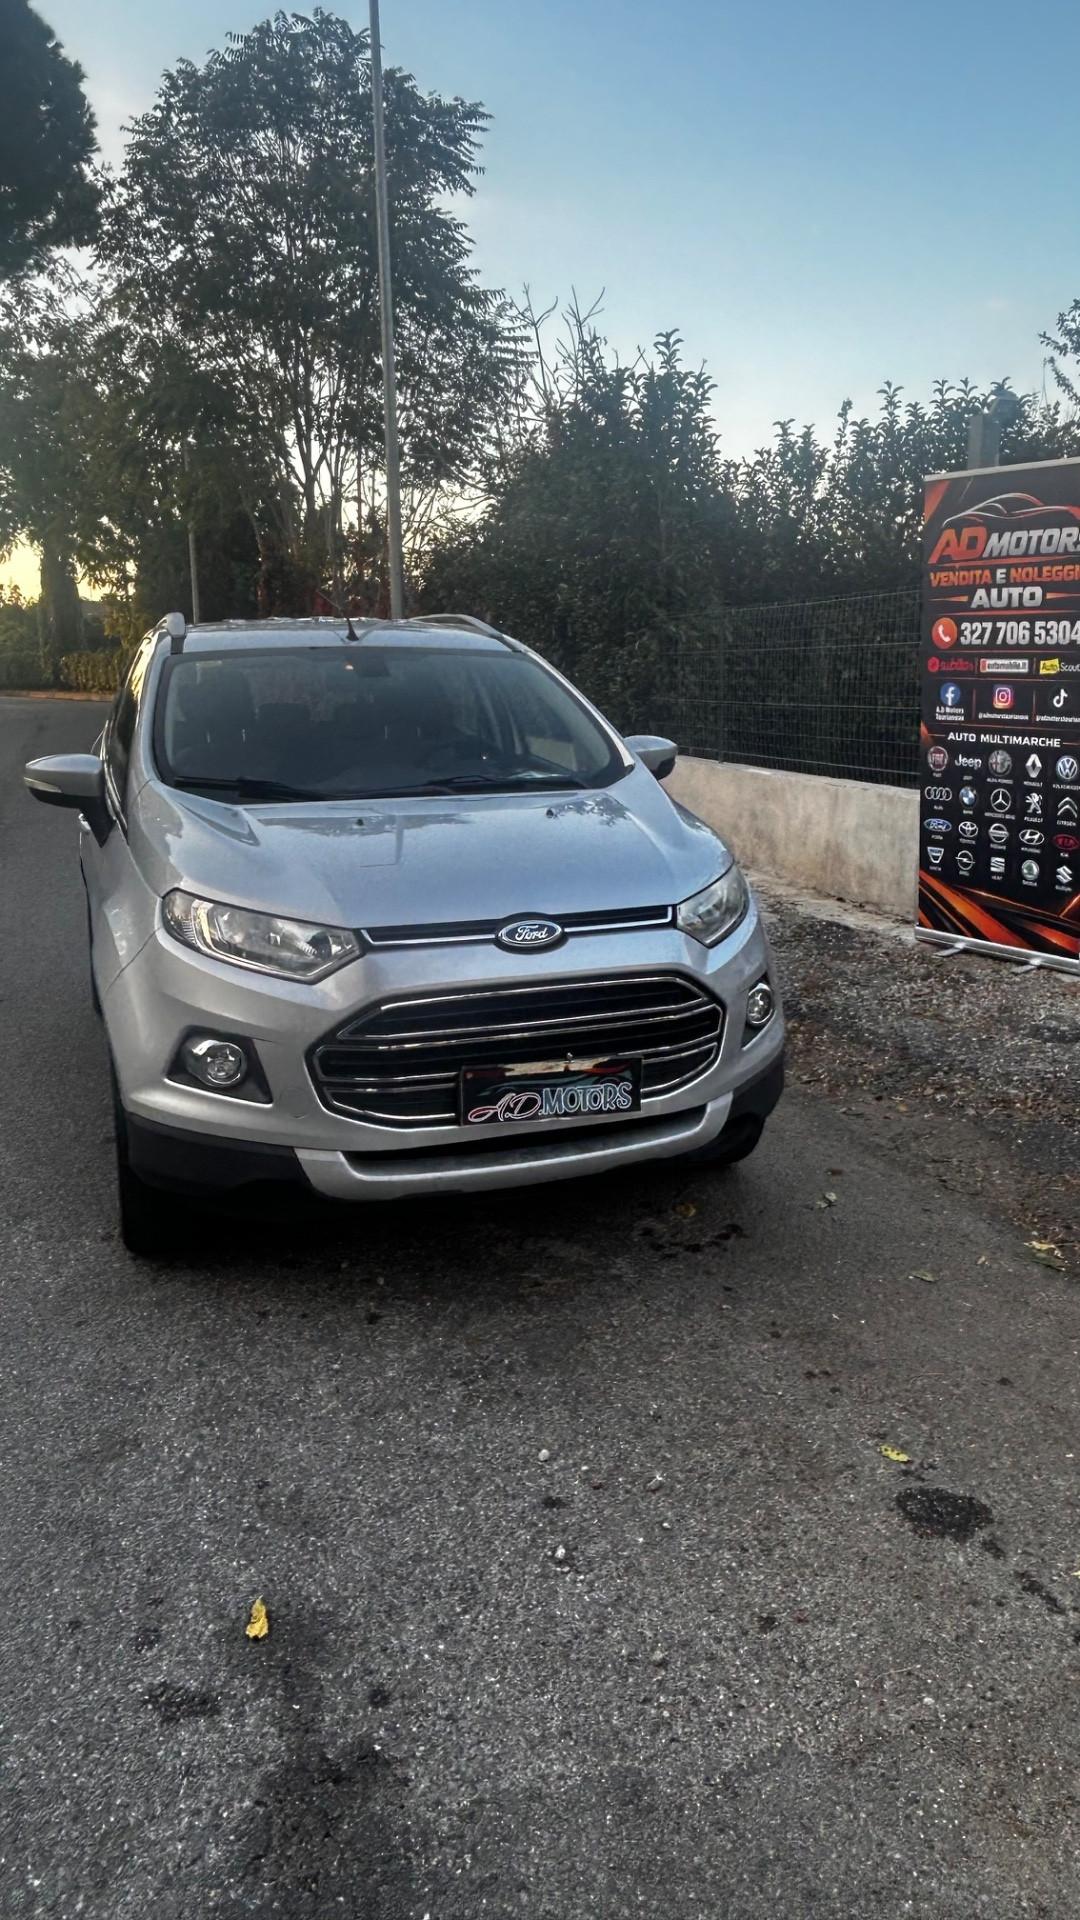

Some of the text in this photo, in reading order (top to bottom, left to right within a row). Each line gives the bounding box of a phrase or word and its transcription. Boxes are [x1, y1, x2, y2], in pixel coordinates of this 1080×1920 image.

[930, 569, 993, 587] VENDITA
[996, 568, 1007, 584] E
[970, 586, 1043, 609] AUTO
[960, 620, 1080, 646] 327 706 5304
[947, 731, 1061, 748] AUTO MULTIMARCHE
[954, 754, 982, 770] Jeep
[515, 925, 548, 940] Ford
